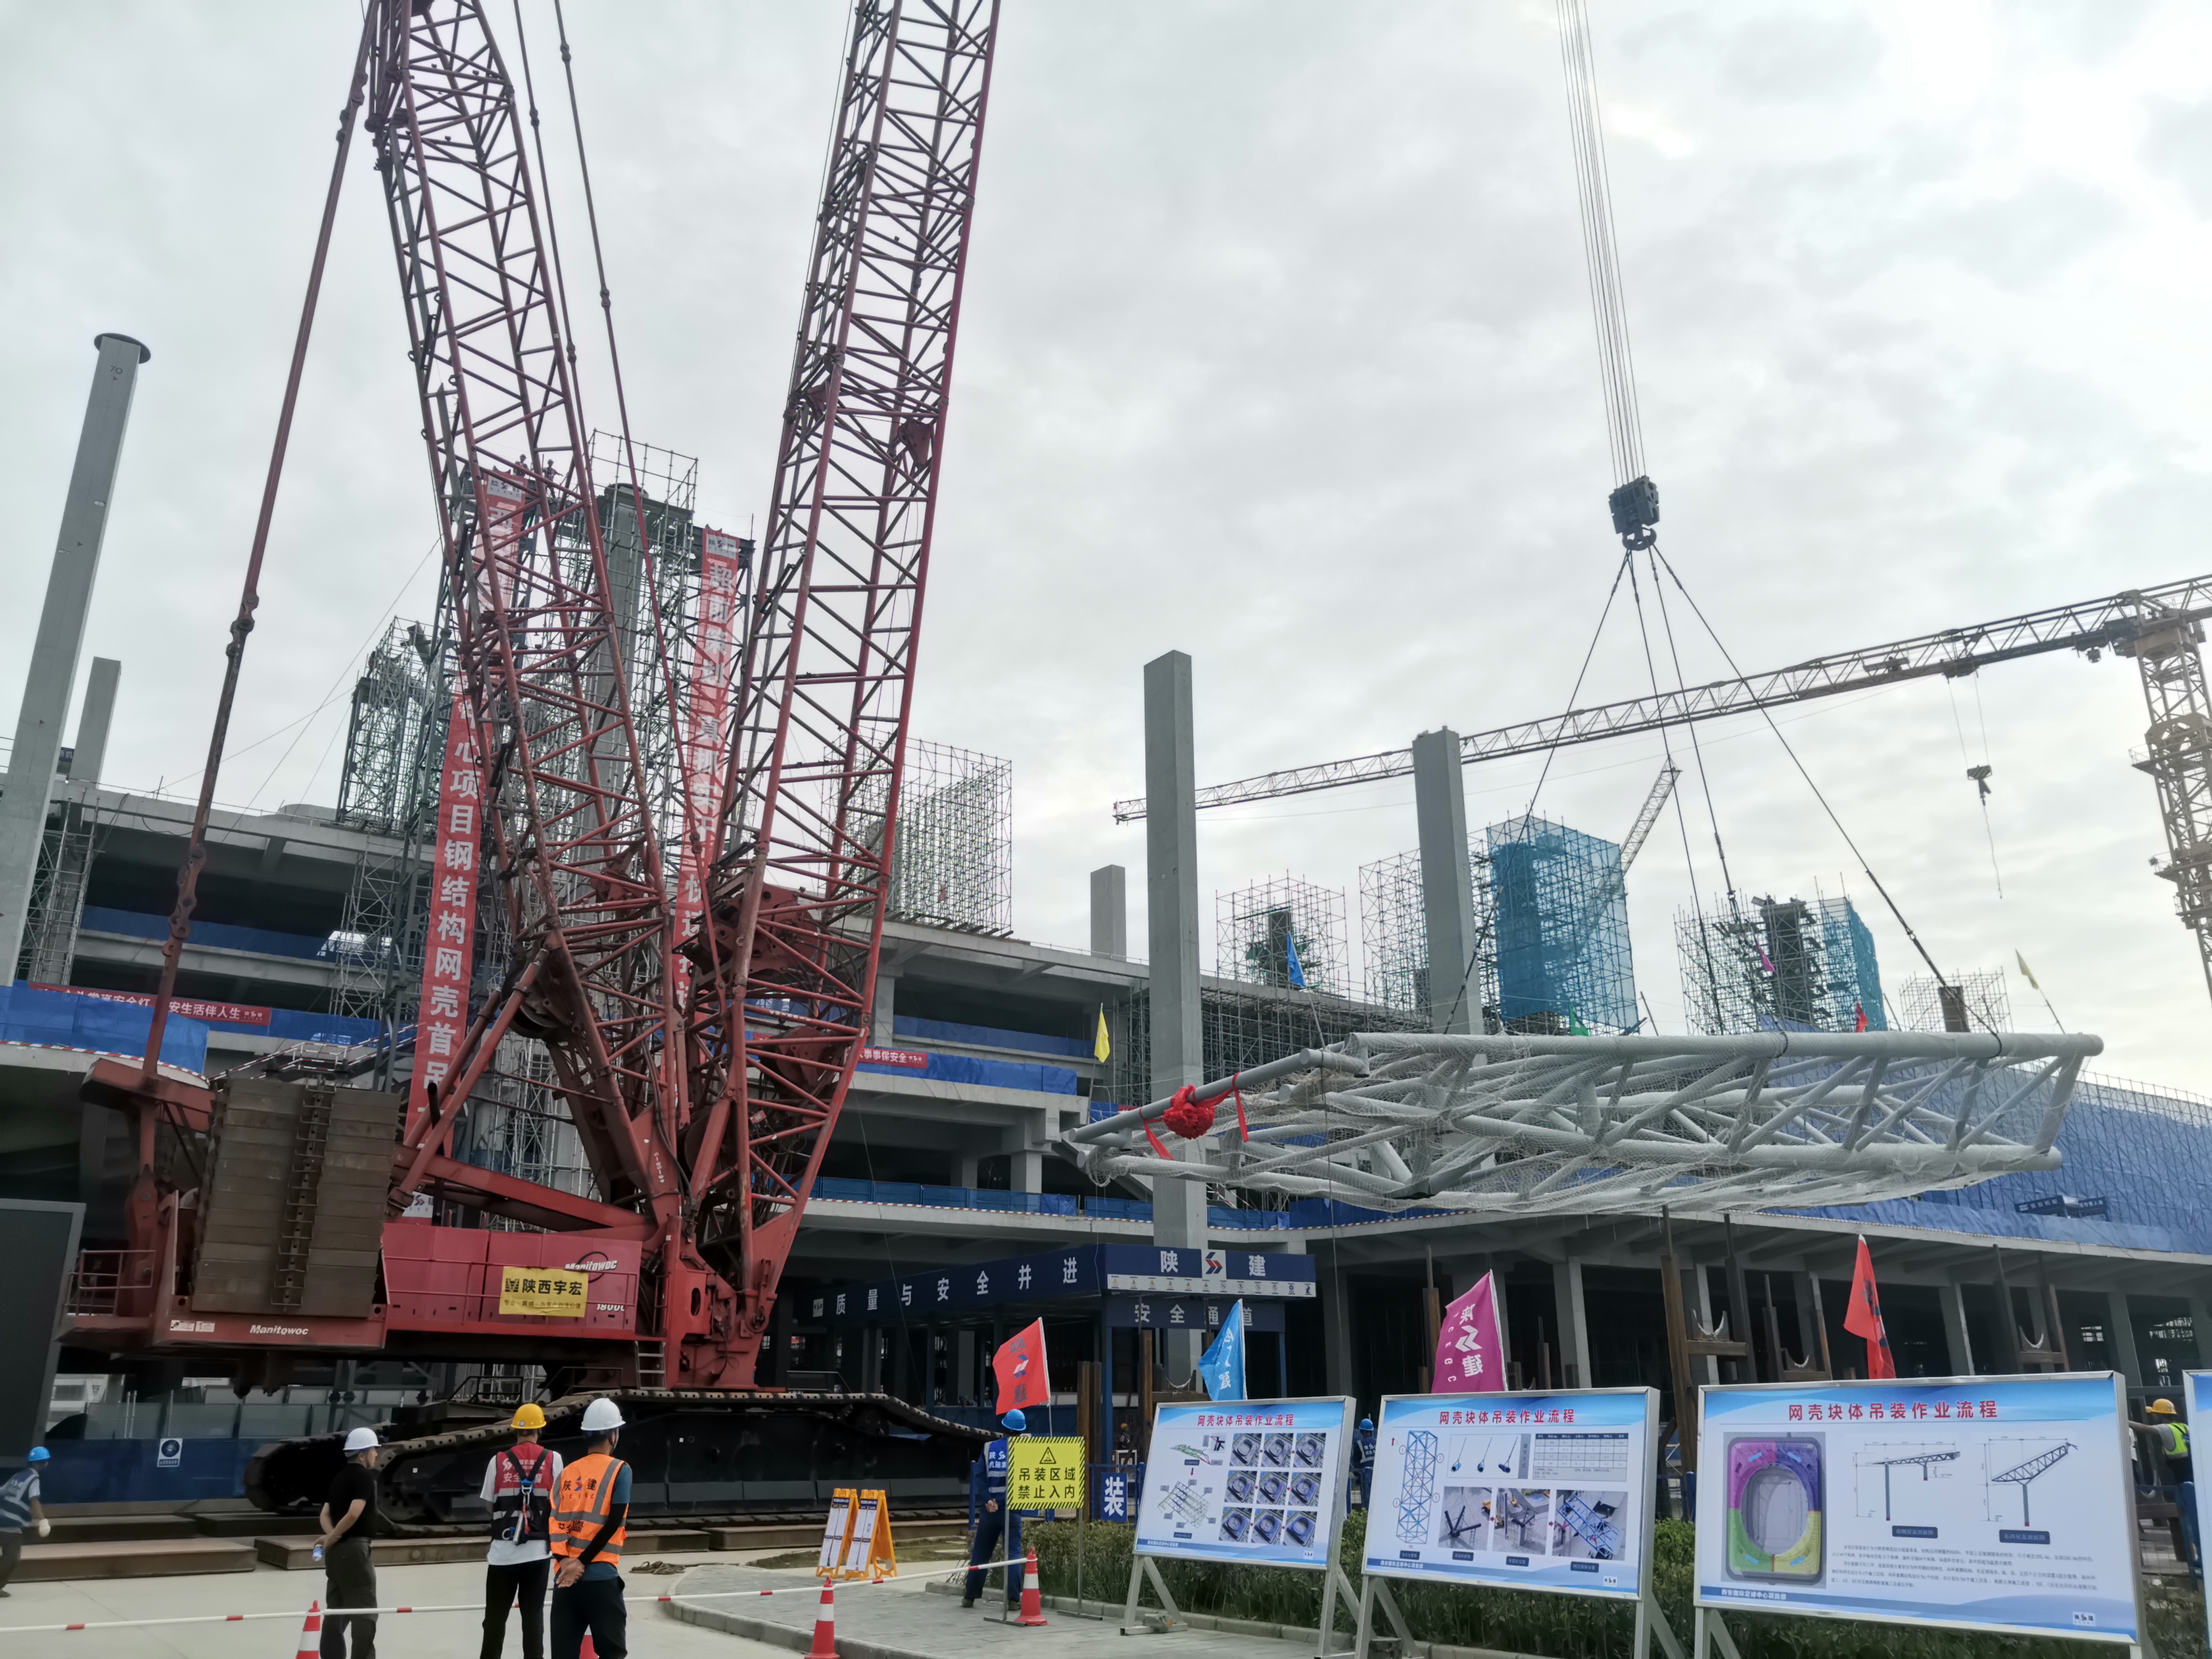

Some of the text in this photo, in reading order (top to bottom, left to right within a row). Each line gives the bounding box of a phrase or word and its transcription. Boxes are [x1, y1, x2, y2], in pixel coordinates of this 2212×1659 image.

[168, 1001, 240, 1020] 安生活伴人生
[860, 1048, 907, 1063] 事事保安全
[522, 1278, 583, 1296] 陕西宇宏
[835, 1257, 1078, 1316] 质量与安全并进
[250, 1324, 309, 1335] Manitowoc
[1439, 1408, 1575, 1425] 网壳块体吊装作业流程
[1789, 1400, 1997, 1421] 网壳块体吊装作业流程
[1197, 1414, 1295, 1427] 网壳块体吊装作业流程
[503, 1472, 543, 1483] 安全督
[1018, 1467, 1076, 1481] 吊装区域
[1018, 1485, 1076, 1500] 禁止入内
[1104, 1476, 1125, 1517] 装
